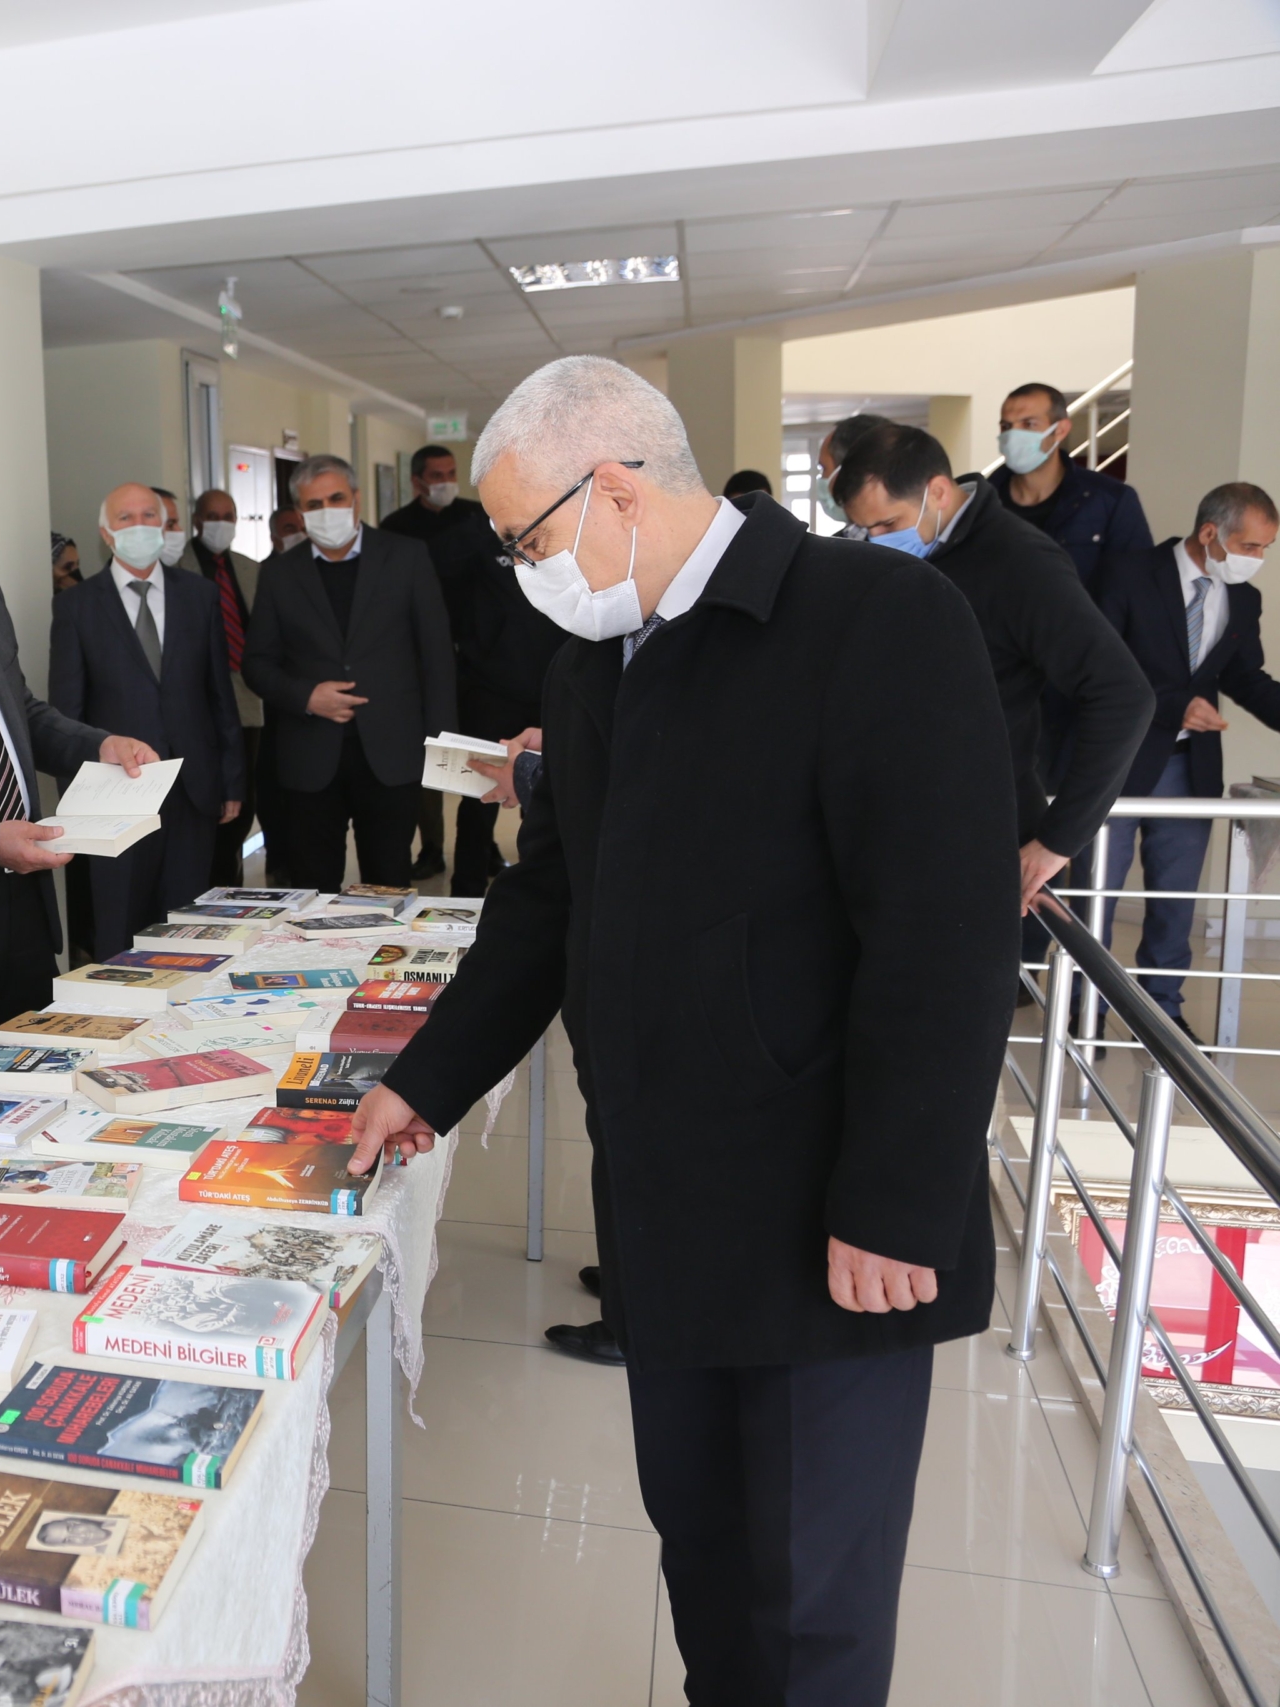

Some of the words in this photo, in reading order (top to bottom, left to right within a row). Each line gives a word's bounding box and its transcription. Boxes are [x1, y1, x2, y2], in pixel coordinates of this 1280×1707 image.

[286, 1057, 314, 1085] Livaneli
[304, 1097, 337, 1105] SERENAD
[338, 1097, 354, 1106] Zülfü
[232, 1193, 251, 1203] ATEŞ
[191, 1243, 224, 1265] ZAFERİ
[105, 1273, 155, 1320] MEDENİ
[105, 1335, 173, 1360] MEDENİ
[177, 1342, 248, 1369] BİLGİLER
[25, 1404, 46, 1423] 100
[36, 1372, 78, 1408] SORUDA
[44, 1373, 98, 1428] ÇANAKKALE
[56, 1375, 120, 1445] MUHAREBELERİ
[101, 1457, 134, 1472] ÇANAKKALE
